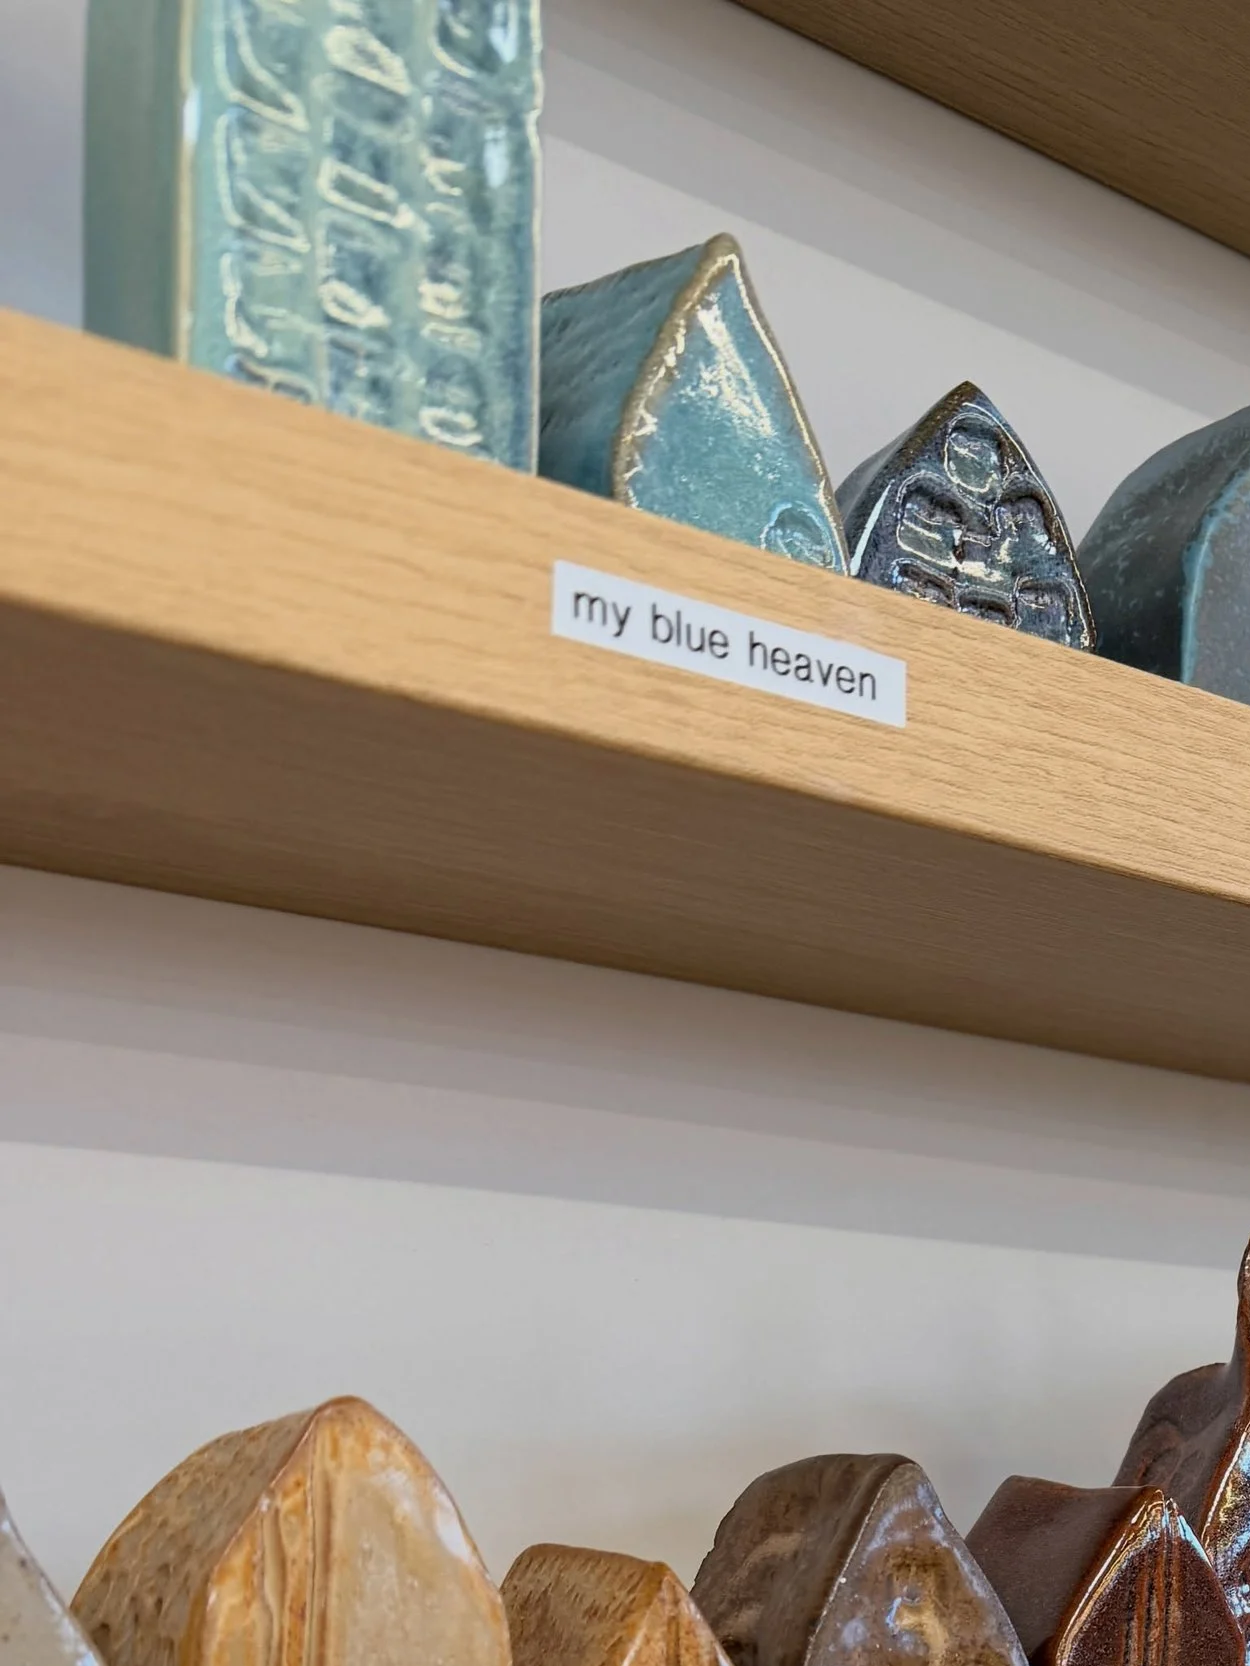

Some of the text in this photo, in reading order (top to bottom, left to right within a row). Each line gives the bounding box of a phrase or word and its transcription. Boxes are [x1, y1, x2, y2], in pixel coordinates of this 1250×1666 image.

[573, 591, 878, 700] my blue heaven
